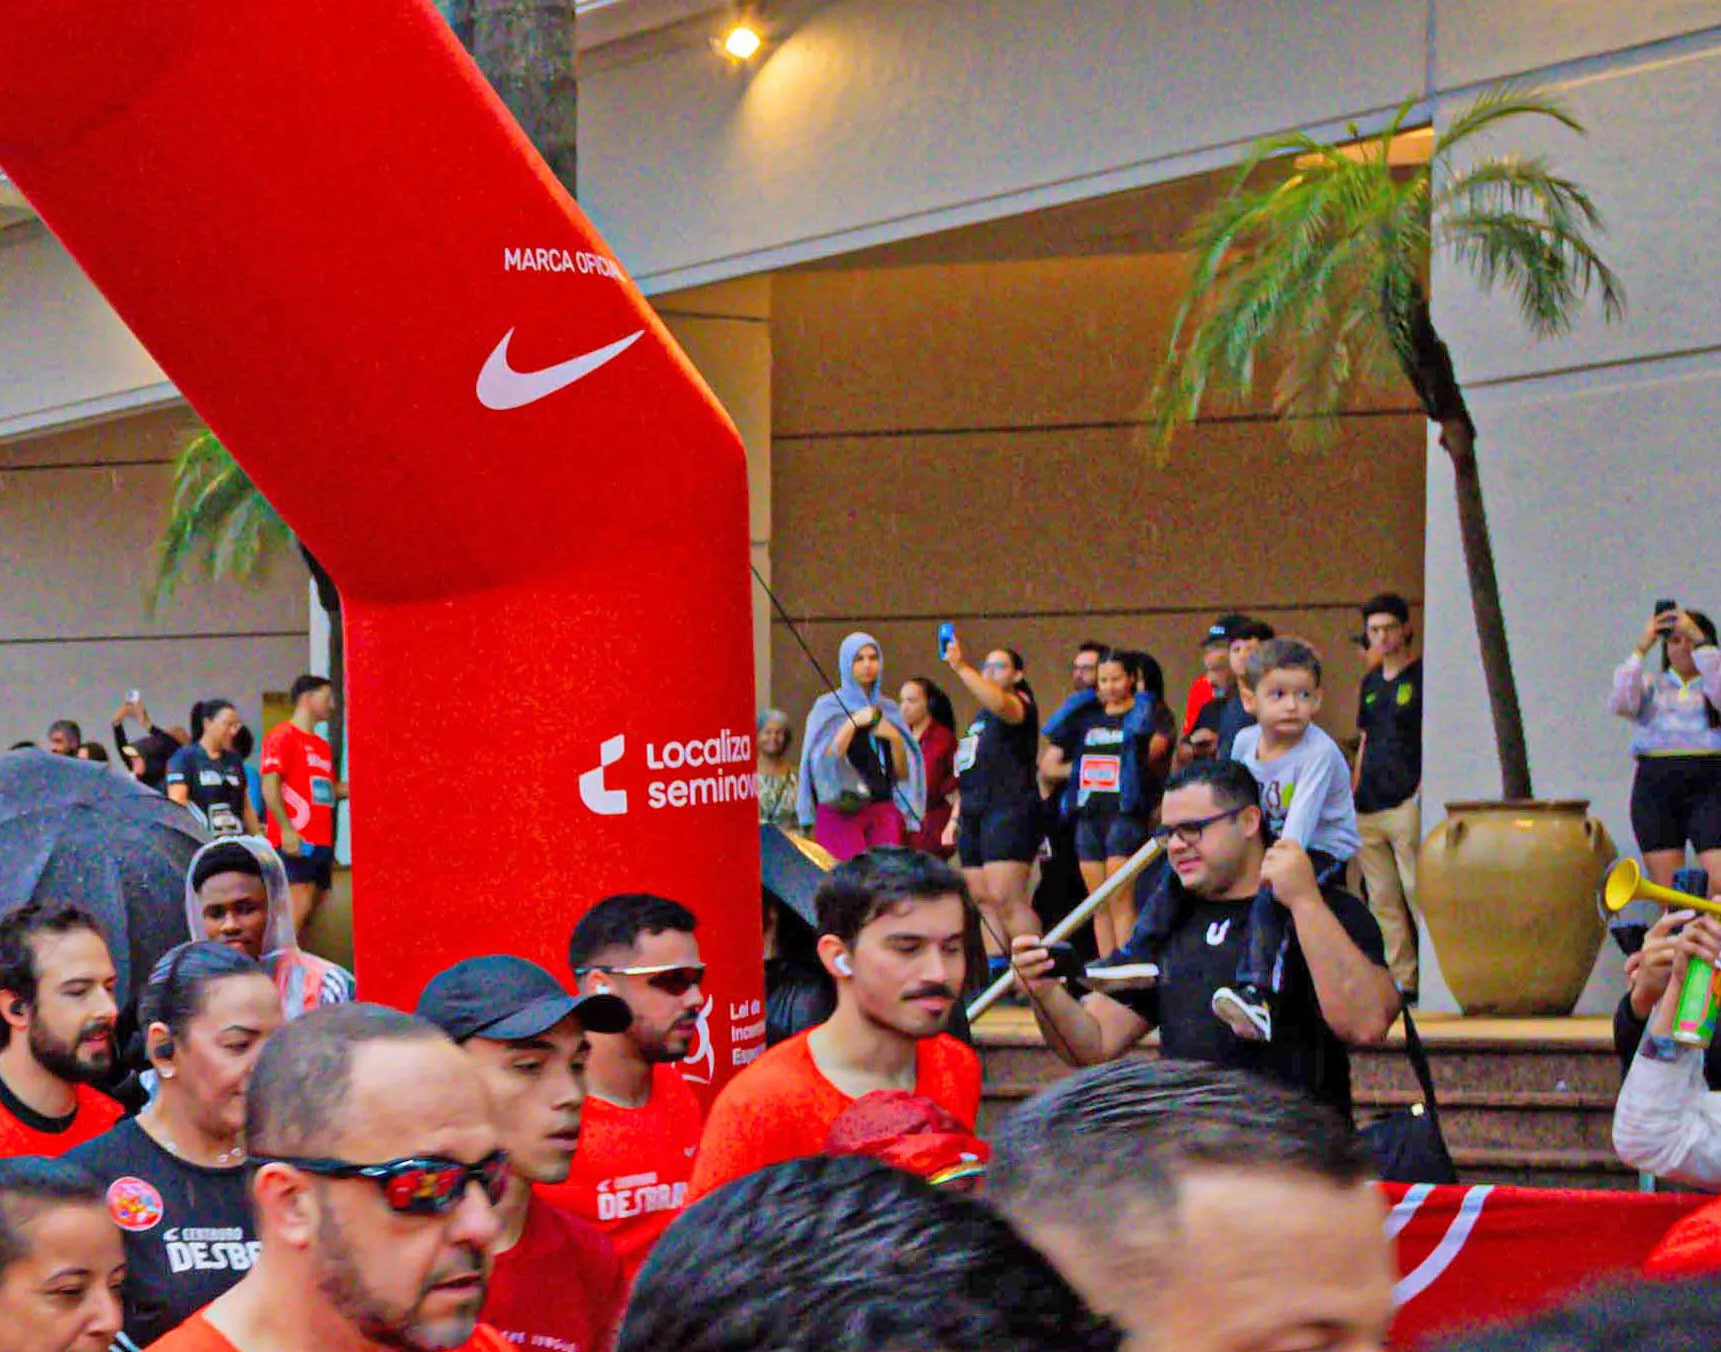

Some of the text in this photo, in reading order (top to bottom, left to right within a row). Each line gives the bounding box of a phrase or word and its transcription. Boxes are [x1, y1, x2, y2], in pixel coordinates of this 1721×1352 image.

[504, 247, 575, 272] MARCA
[645, 727, 751, 771] Localiza
[648, 767, 759, 809] seminov
